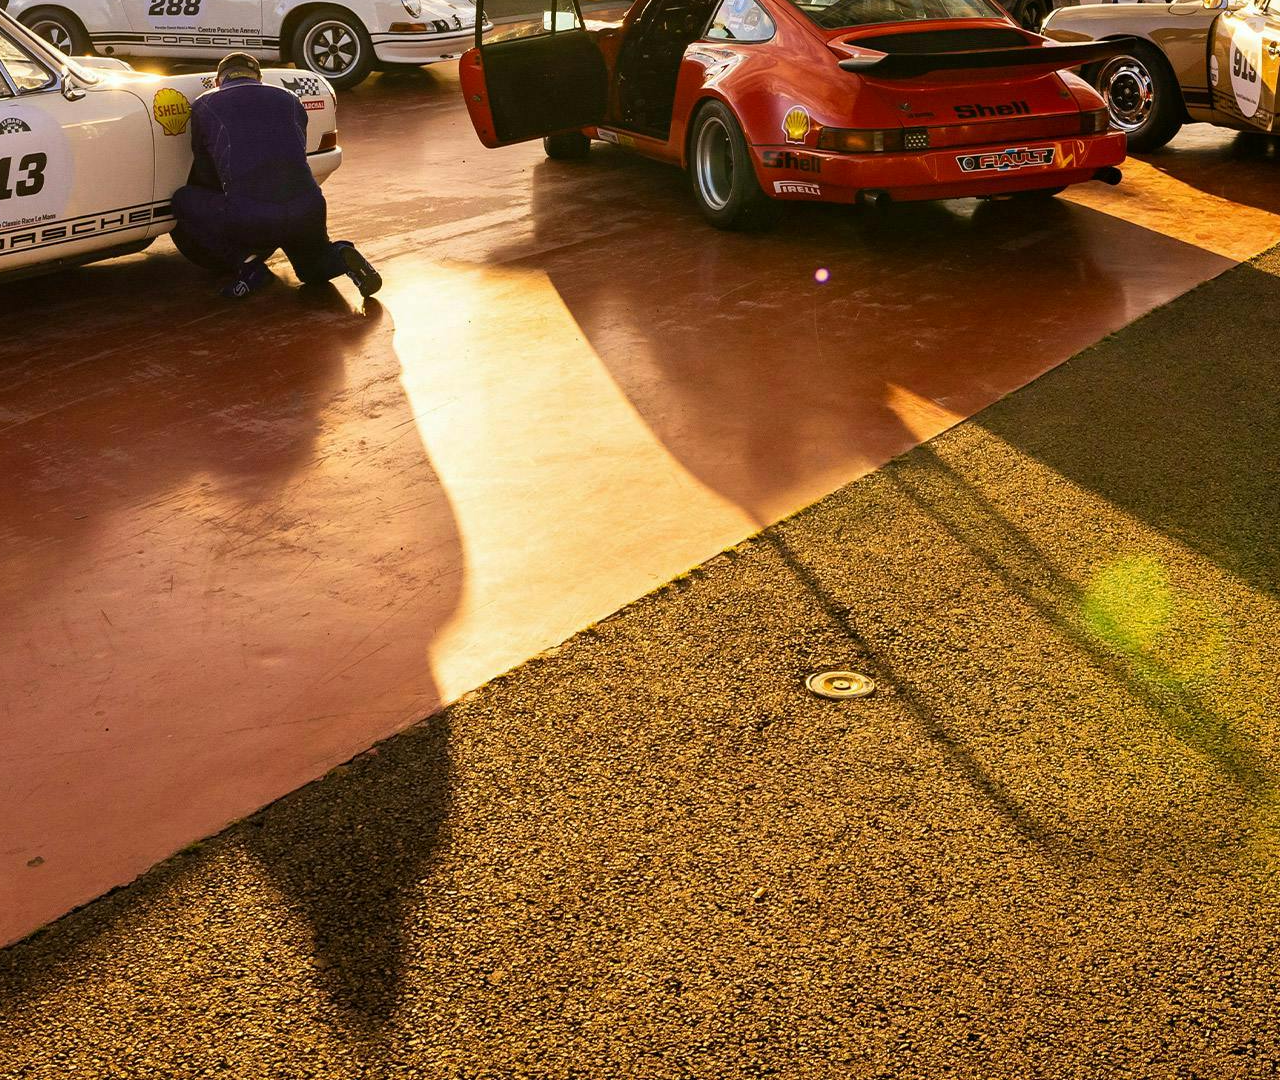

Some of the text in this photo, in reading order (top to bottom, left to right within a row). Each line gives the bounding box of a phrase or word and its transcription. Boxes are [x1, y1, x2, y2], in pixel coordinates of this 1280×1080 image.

[240, 27, 261, 35] Annecy
[146, 35, 262, 46] PORSCHE
[1233, 46, 1257, 83] 919
[157, 102, 187, 117] SHELL
[953, 100, 1031, 119] Shell
[762, 151, 820, 173] Shell
[979, 151, 1047, 168] FIAULT
[773, 180, 820, 195] PIRELLI
[2, 218, 21, 228] Classic
[22, 217, 34, 225] Race
[35, 215, 42, 223] Le
[42, 213, 56, 222] Mans
